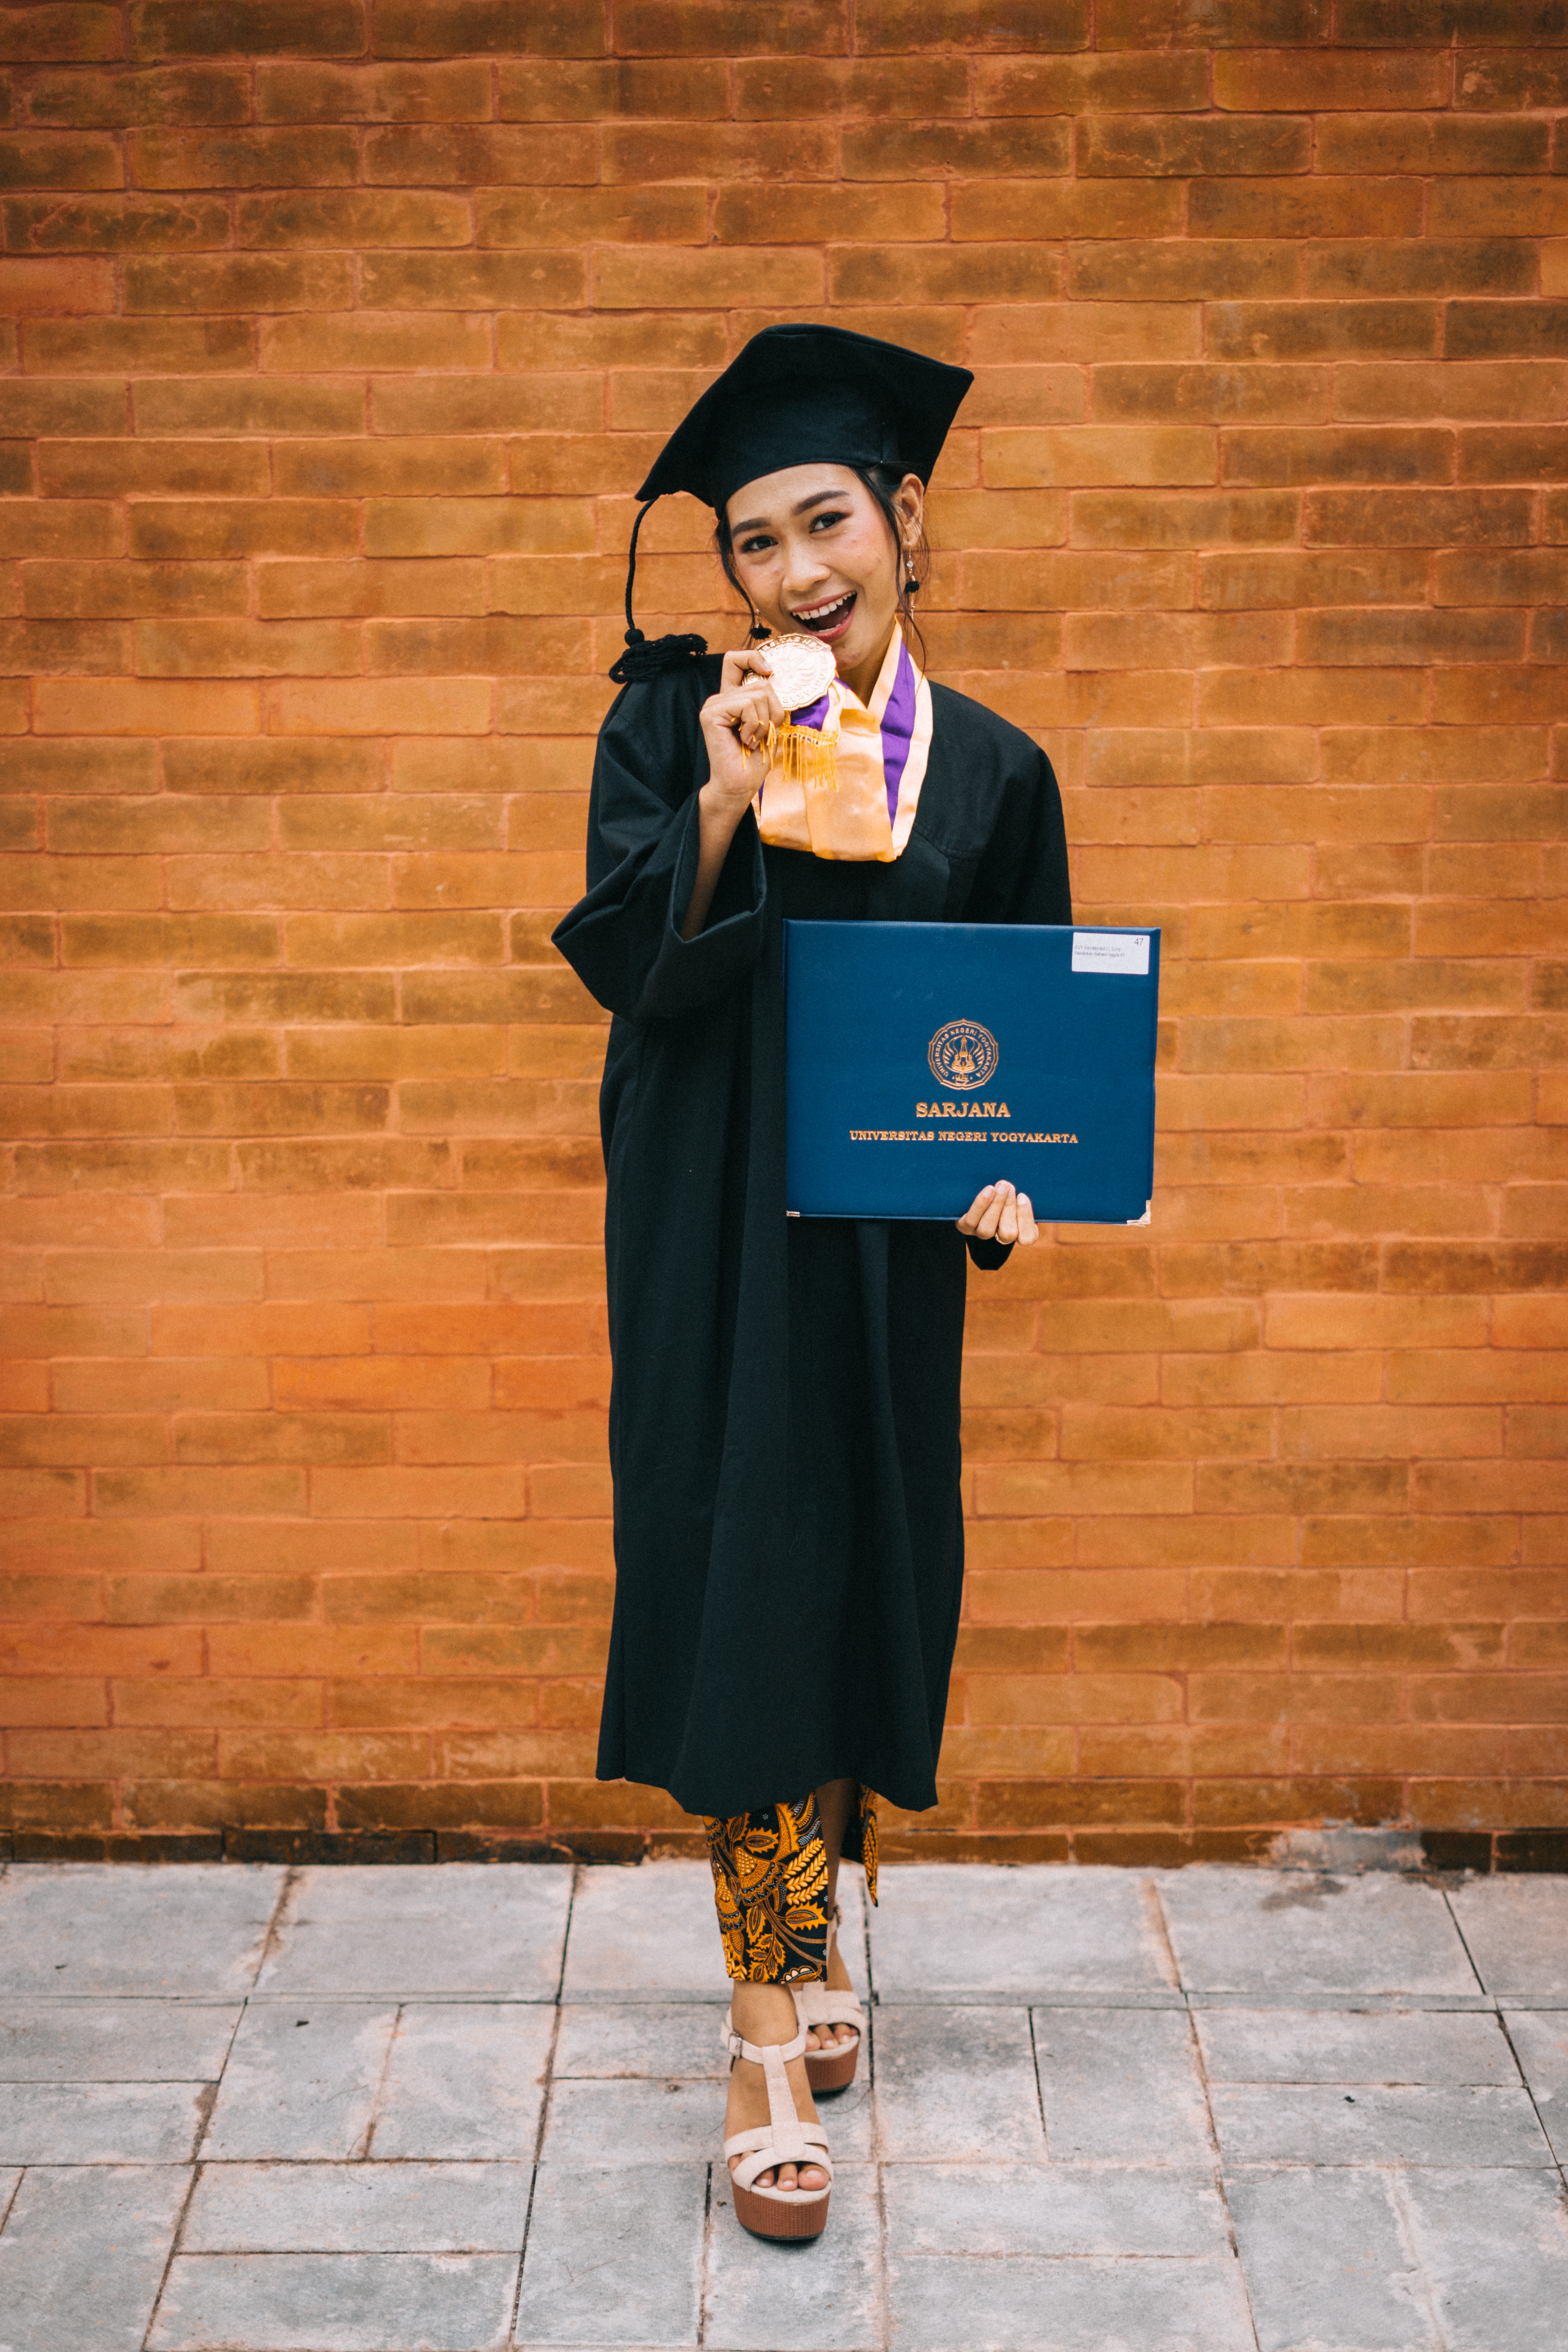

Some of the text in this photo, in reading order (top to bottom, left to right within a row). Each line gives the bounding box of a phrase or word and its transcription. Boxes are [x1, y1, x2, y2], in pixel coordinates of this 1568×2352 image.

[1134, 938, 1144, 946] 47
[935, 1027, 992, 1077] UNIVERSITAS NEGERI YOGYAKARTA
[916, 1102, 1011, 1117] SARJANA
[850, 1130, 1078, 1143] UNIVERSITAS NEGERI YOGYAKARTA
